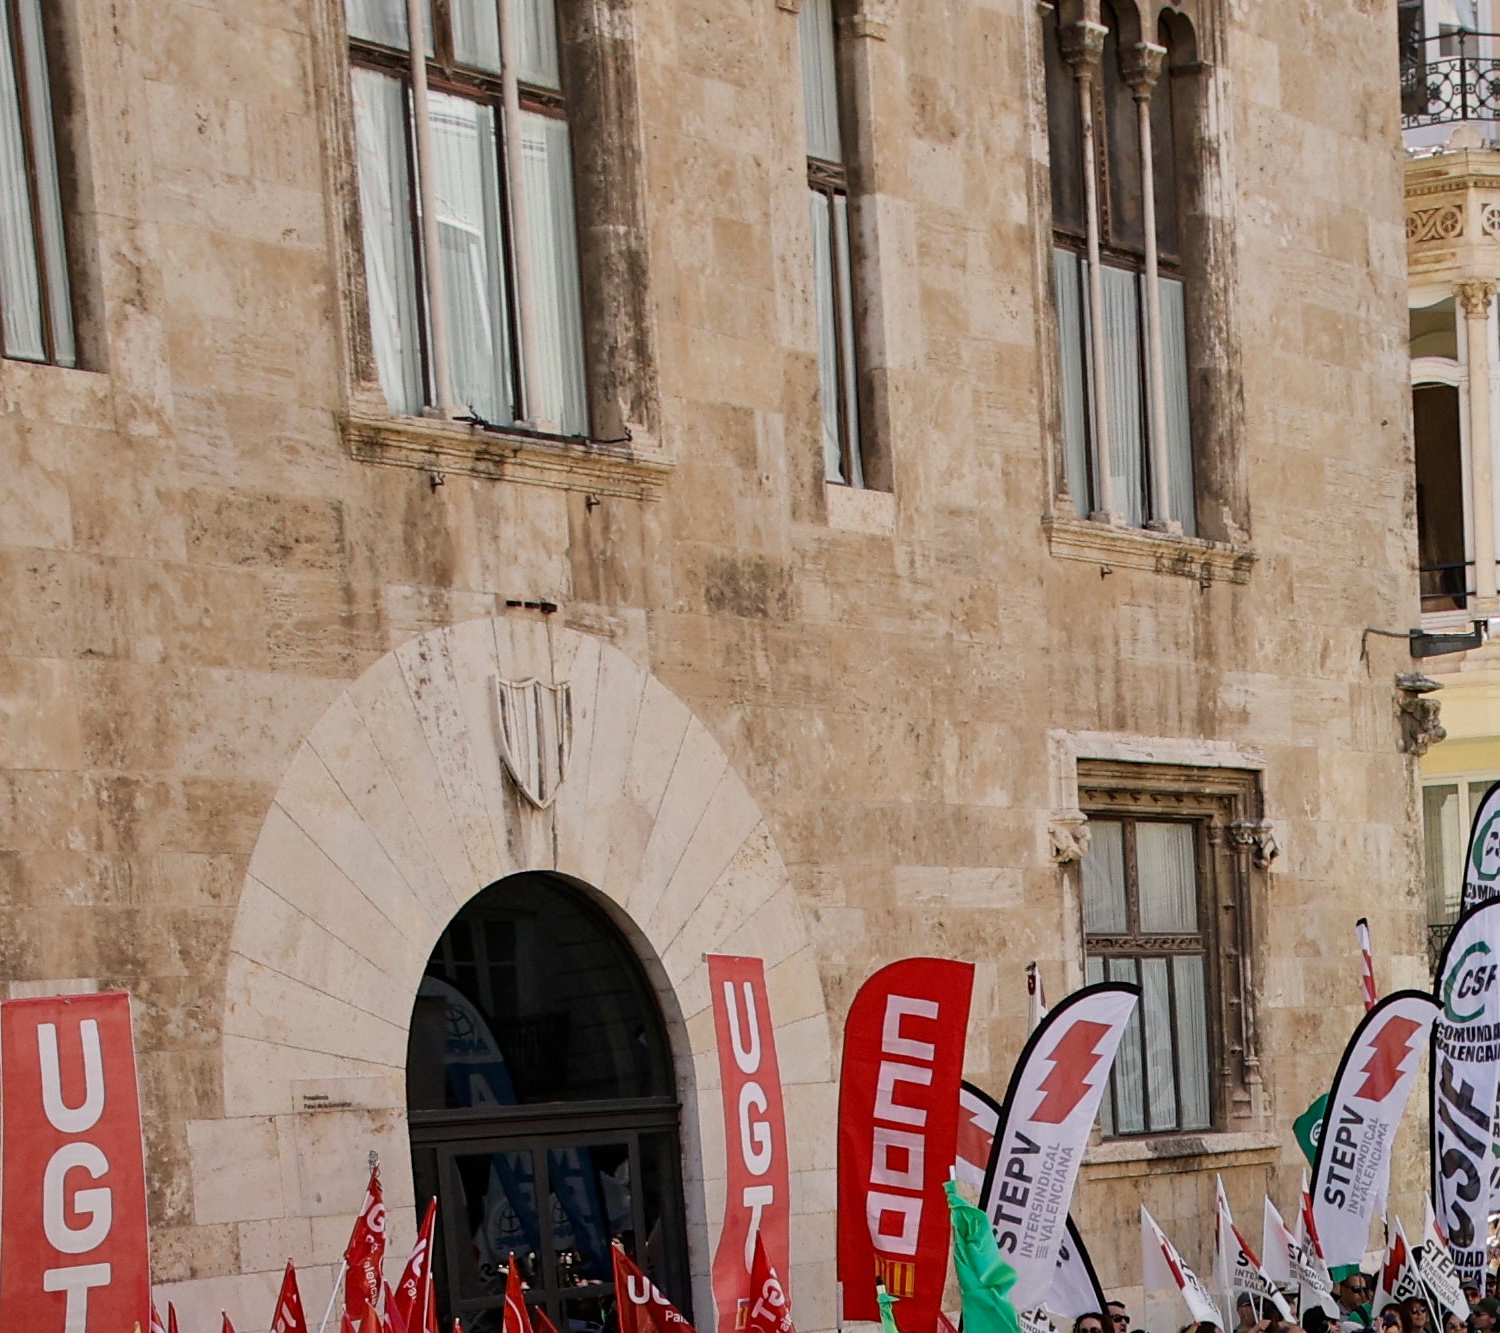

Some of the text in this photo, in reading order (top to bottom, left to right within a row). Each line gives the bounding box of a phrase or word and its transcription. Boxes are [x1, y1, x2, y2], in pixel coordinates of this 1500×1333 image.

[867, 995, 939, 1255] CCOO
[1325, 1106, 1364, 1208] STEPV
[992, 1131, 1042, 1254] STEPV
